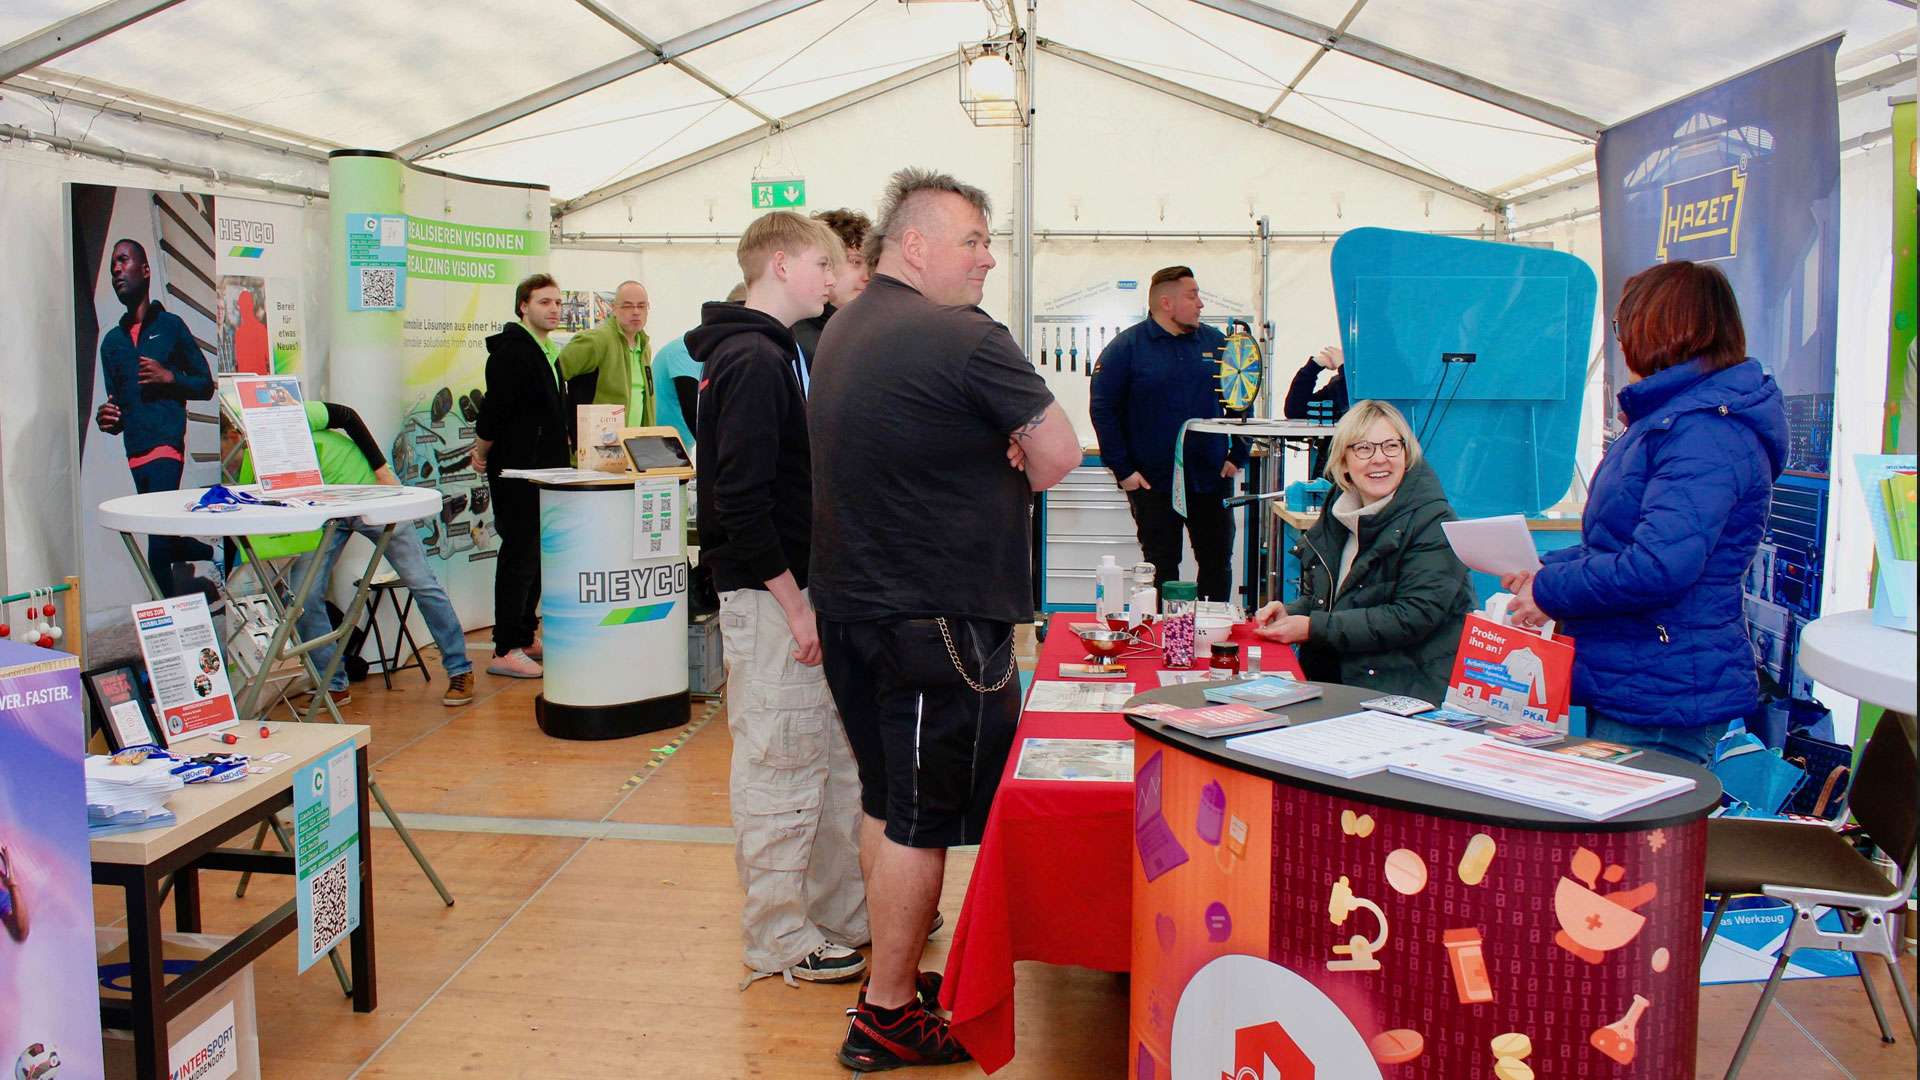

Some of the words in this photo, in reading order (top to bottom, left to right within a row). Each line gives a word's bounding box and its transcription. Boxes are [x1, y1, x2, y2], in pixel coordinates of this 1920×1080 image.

[1666, 194, 1734, 244] HAZET
[219, 218, 274, 244] HEYCO
[464, 231, 524, 250] VISIONEN
[452, 260, 496, 279] VISIONS
[278, 329, 296, 338] etwas
[424, 319, 453, 333] Lösungen
[454, 322, 466, 331] aus
[467, 321, 489, 331] einer
[491, 320, 503, 331] Ha
[468, 339, 483, 349] one
[579, 562, 687, 603] HEYCO
[1469, 636, 1485, 649] ihn
[1471, 626, 1507, 645] Probier
[26, 686, 73, 706] FASTER.
[1490, 698, 1510, 711] PTA
[1522, 709, 1544, 722] PKA
[1720, 918, 1733, 926] as
[1734, 914, 1784, 925] Werkzeug
[179, 1026, 233, 1079] INTERSPORT
